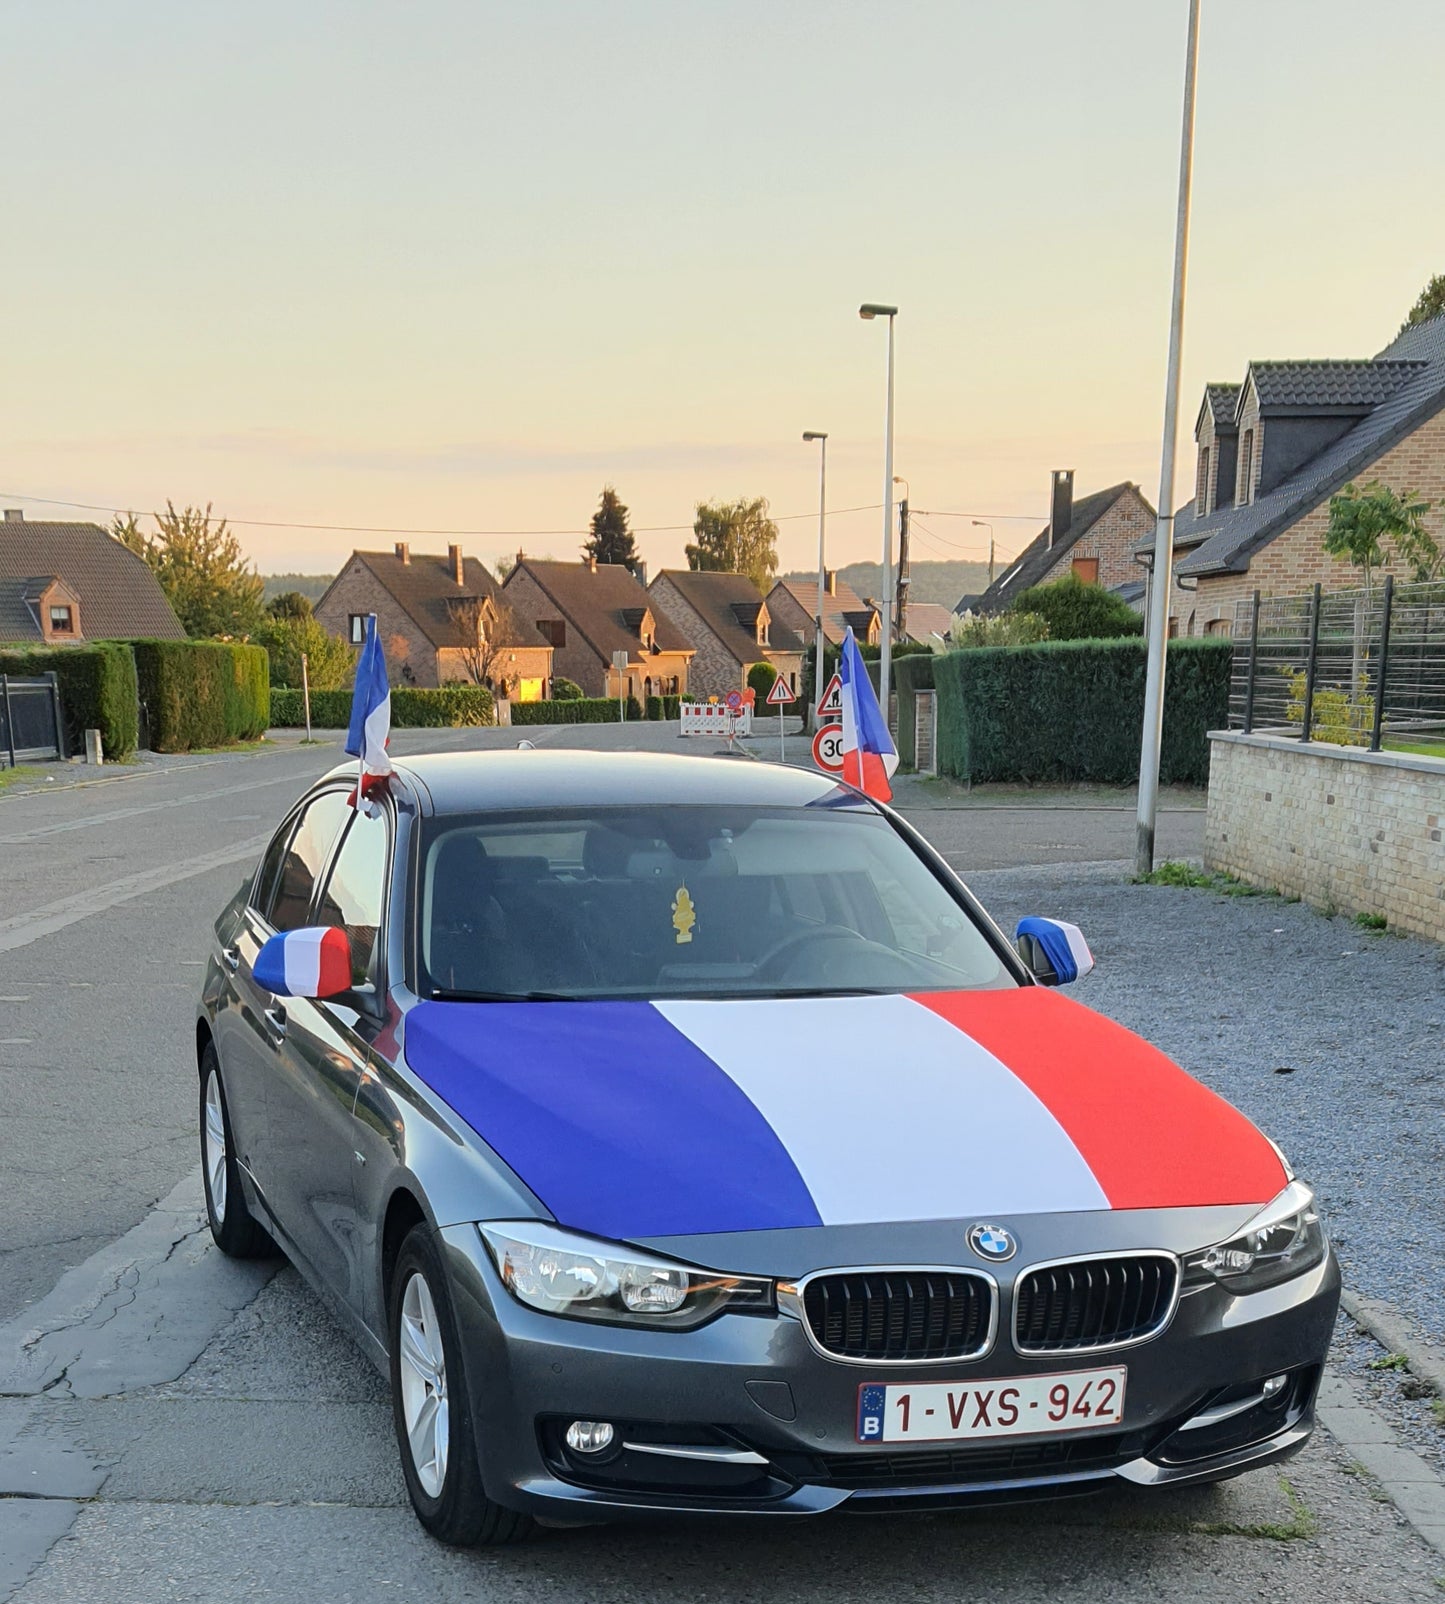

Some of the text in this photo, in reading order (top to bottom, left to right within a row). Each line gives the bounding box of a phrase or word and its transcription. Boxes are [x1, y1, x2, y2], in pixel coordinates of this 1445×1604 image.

[823, 738, 844, 758] 30
[973, 1225, 1008, 1238] BMW
[864, 1416, 880, 1435] B
